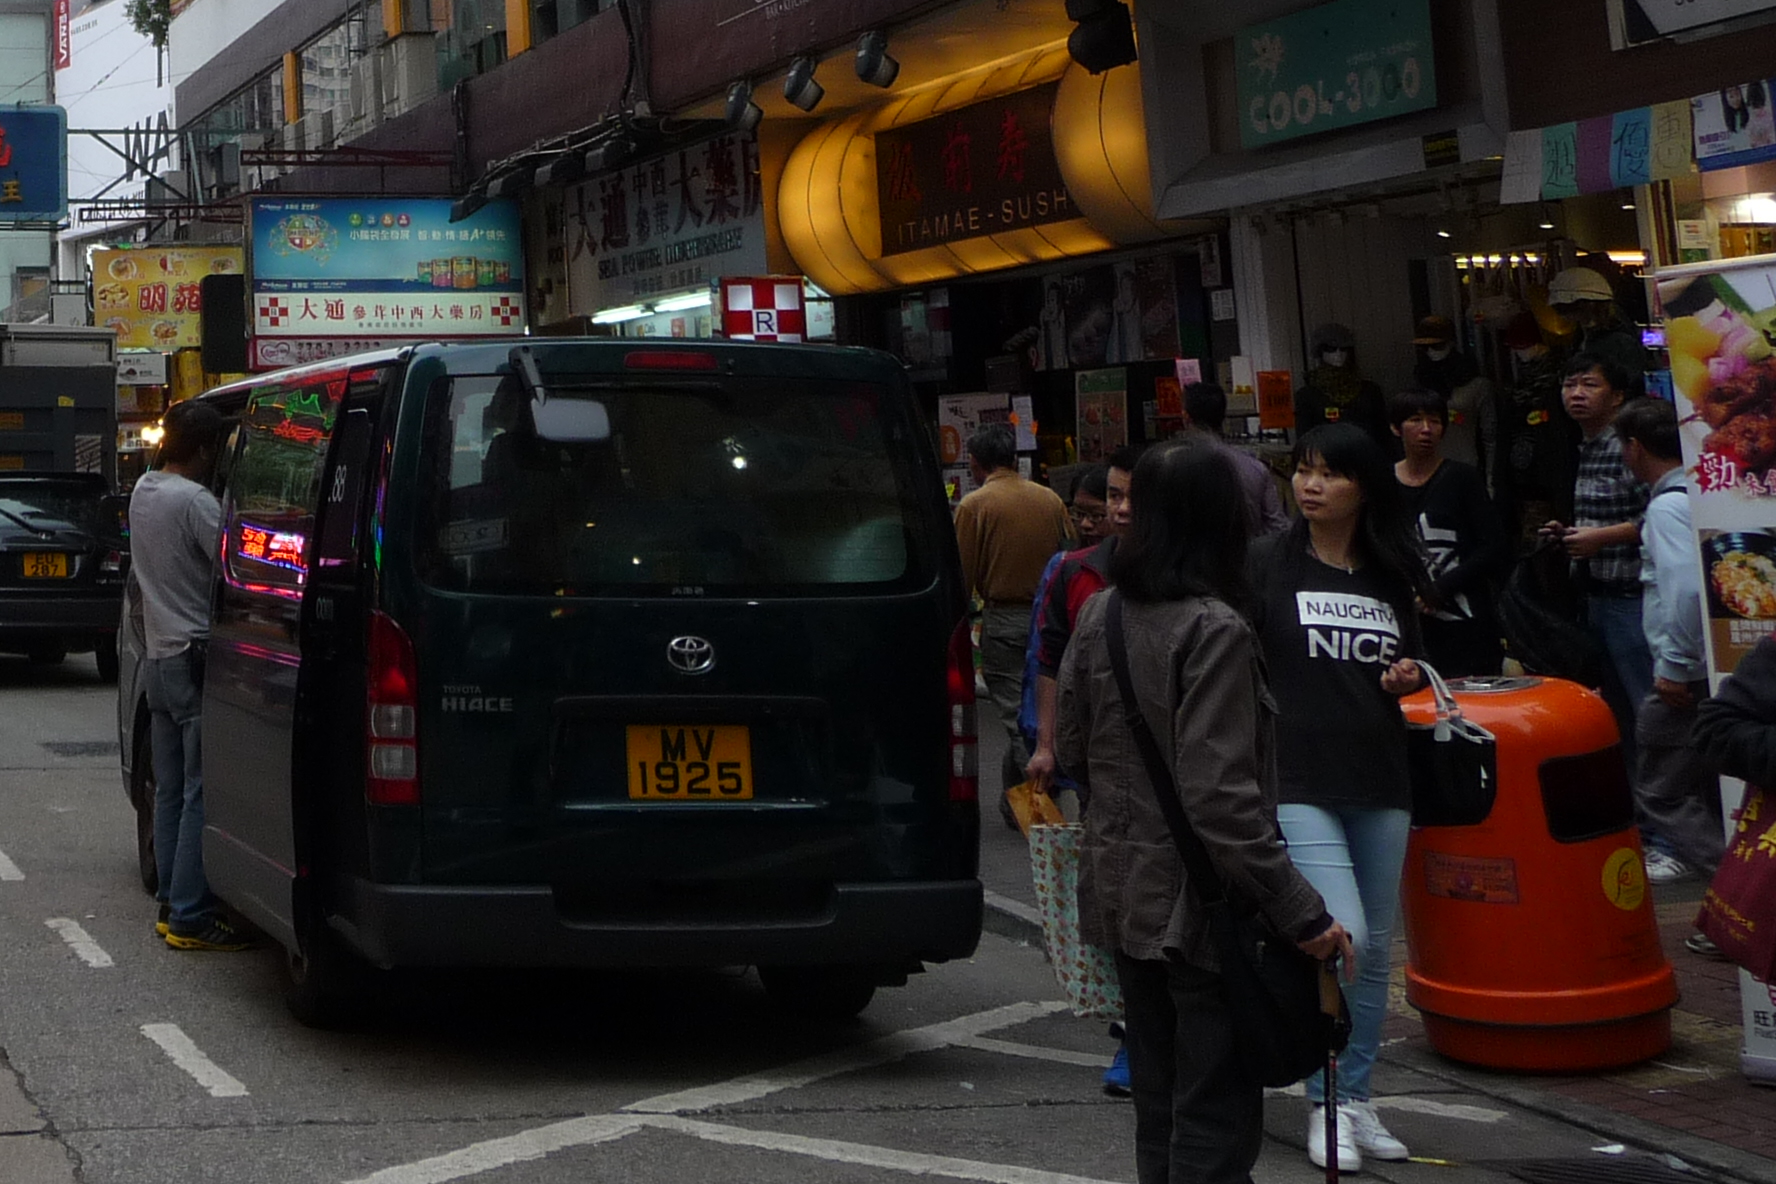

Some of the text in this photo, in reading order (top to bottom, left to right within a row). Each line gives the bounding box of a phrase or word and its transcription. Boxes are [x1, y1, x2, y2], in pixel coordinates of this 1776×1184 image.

[30, 564, 60, 578] 287
[1306, 600, 1394, 626] NAUGHTY
[1307, 627, 1399, 667] NICE
[442, 684, 483, 695] TOYOTA
[440, 695, 514, 713] HIACE
[660, 727, 717, 763] MV
[638, 760, 743, 796] 1925
